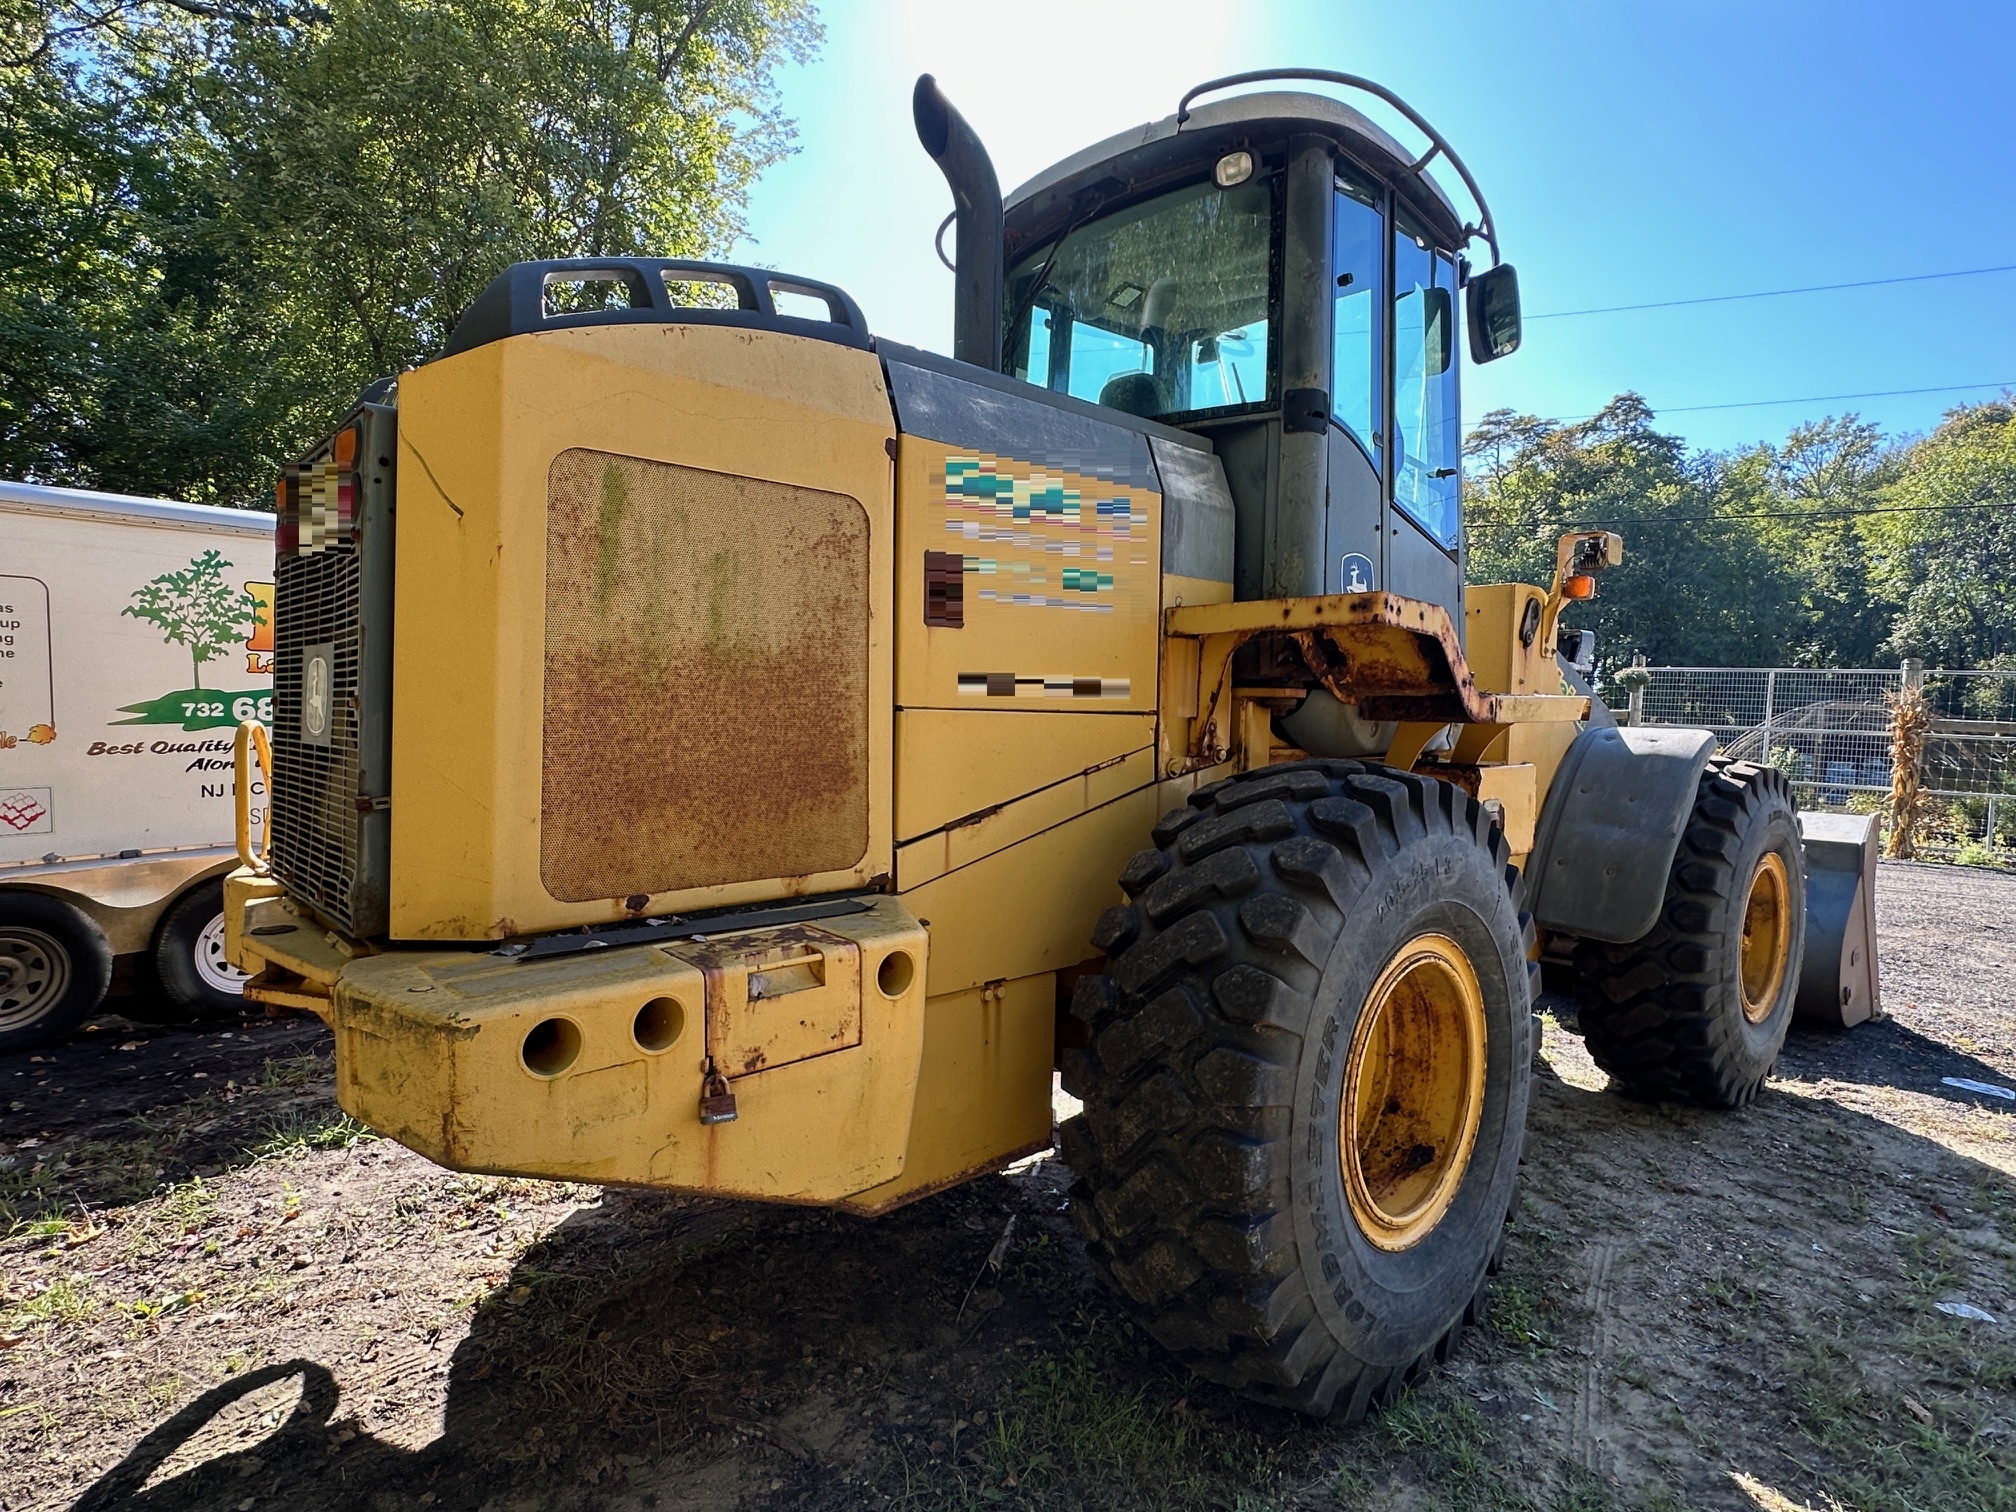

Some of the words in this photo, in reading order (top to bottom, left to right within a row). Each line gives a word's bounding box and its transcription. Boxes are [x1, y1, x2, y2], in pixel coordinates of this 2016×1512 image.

[181, 702, 225, 717] 732
[86, 741, 145, 756] Best
[150, 739, 236, 755] Quality
[185, 757, 236, 773] Alon
[201, 783, 224, 798] NJ
[1307, 1013, 1378, 1336] LOADMASTER
